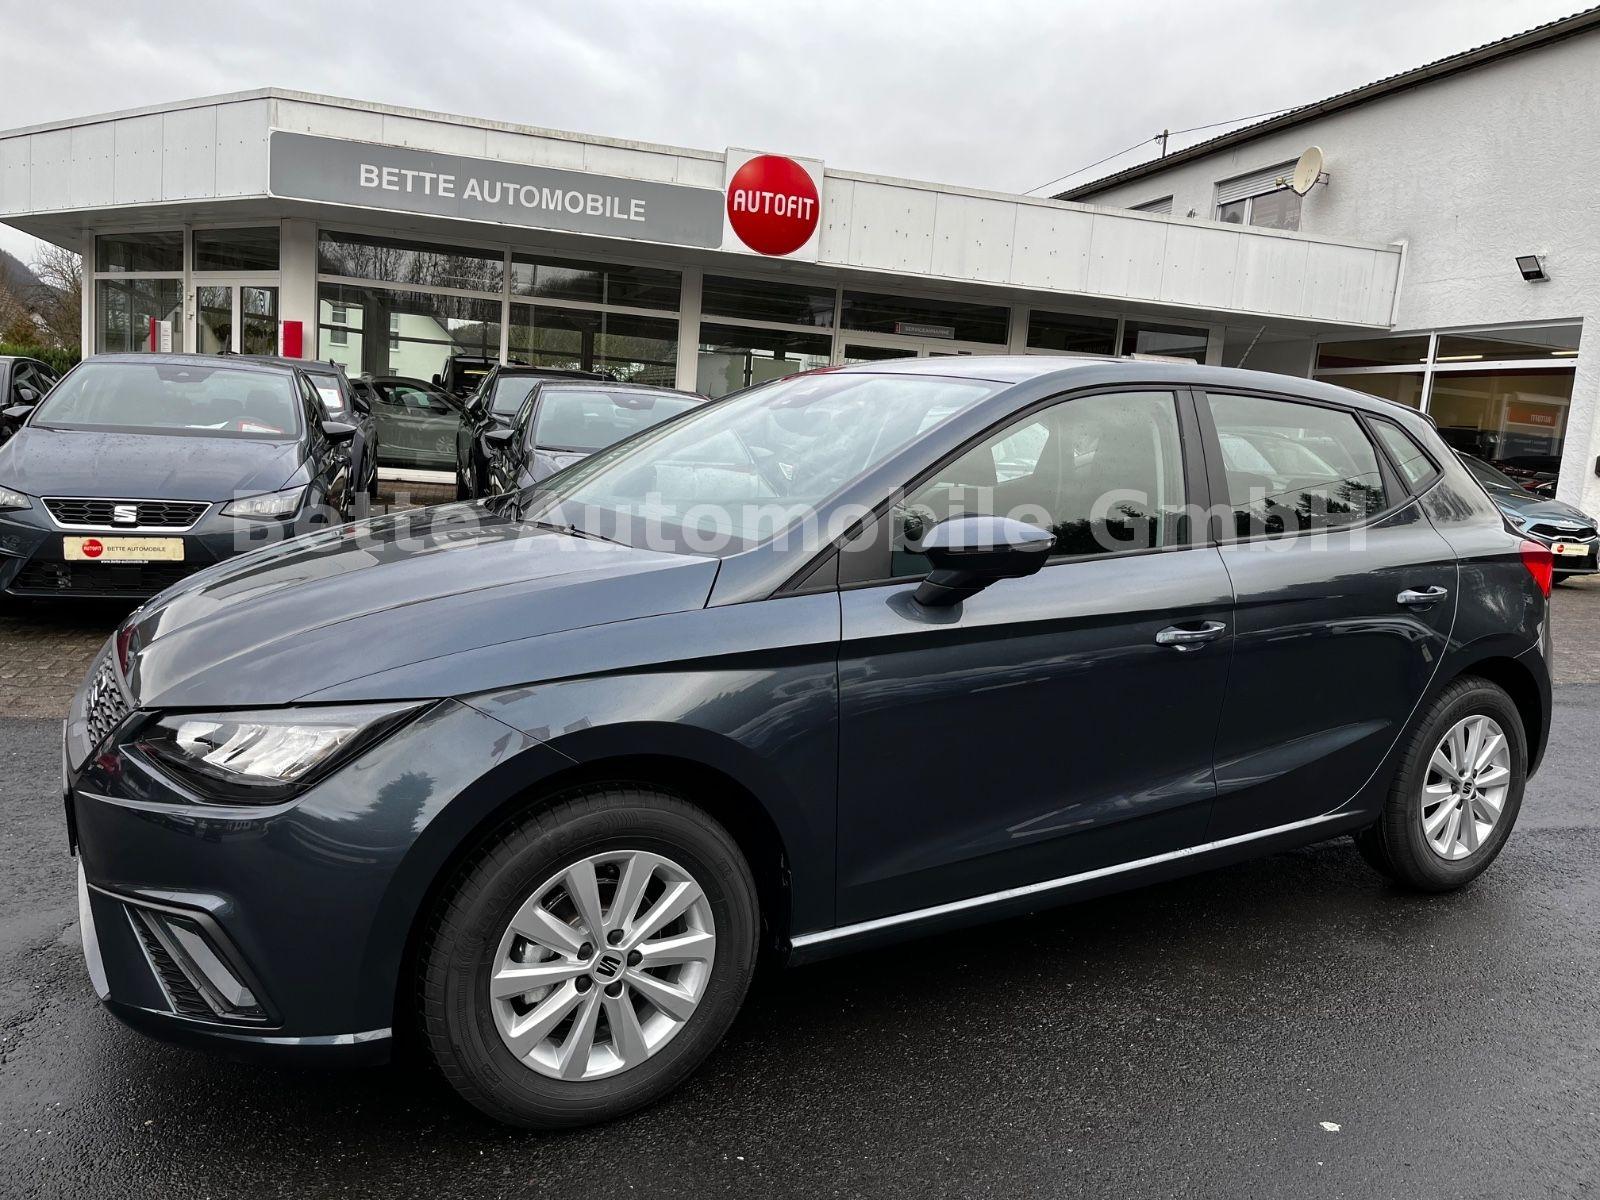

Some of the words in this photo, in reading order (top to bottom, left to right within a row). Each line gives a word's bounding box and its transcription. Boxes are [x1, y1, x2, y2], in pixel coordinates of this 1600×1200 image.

[358, 163, 456, 199] BETTE
[463, 178, 646, 222] AUTOMOBILE
[733, 189, 815, 222] AUTOFIT
